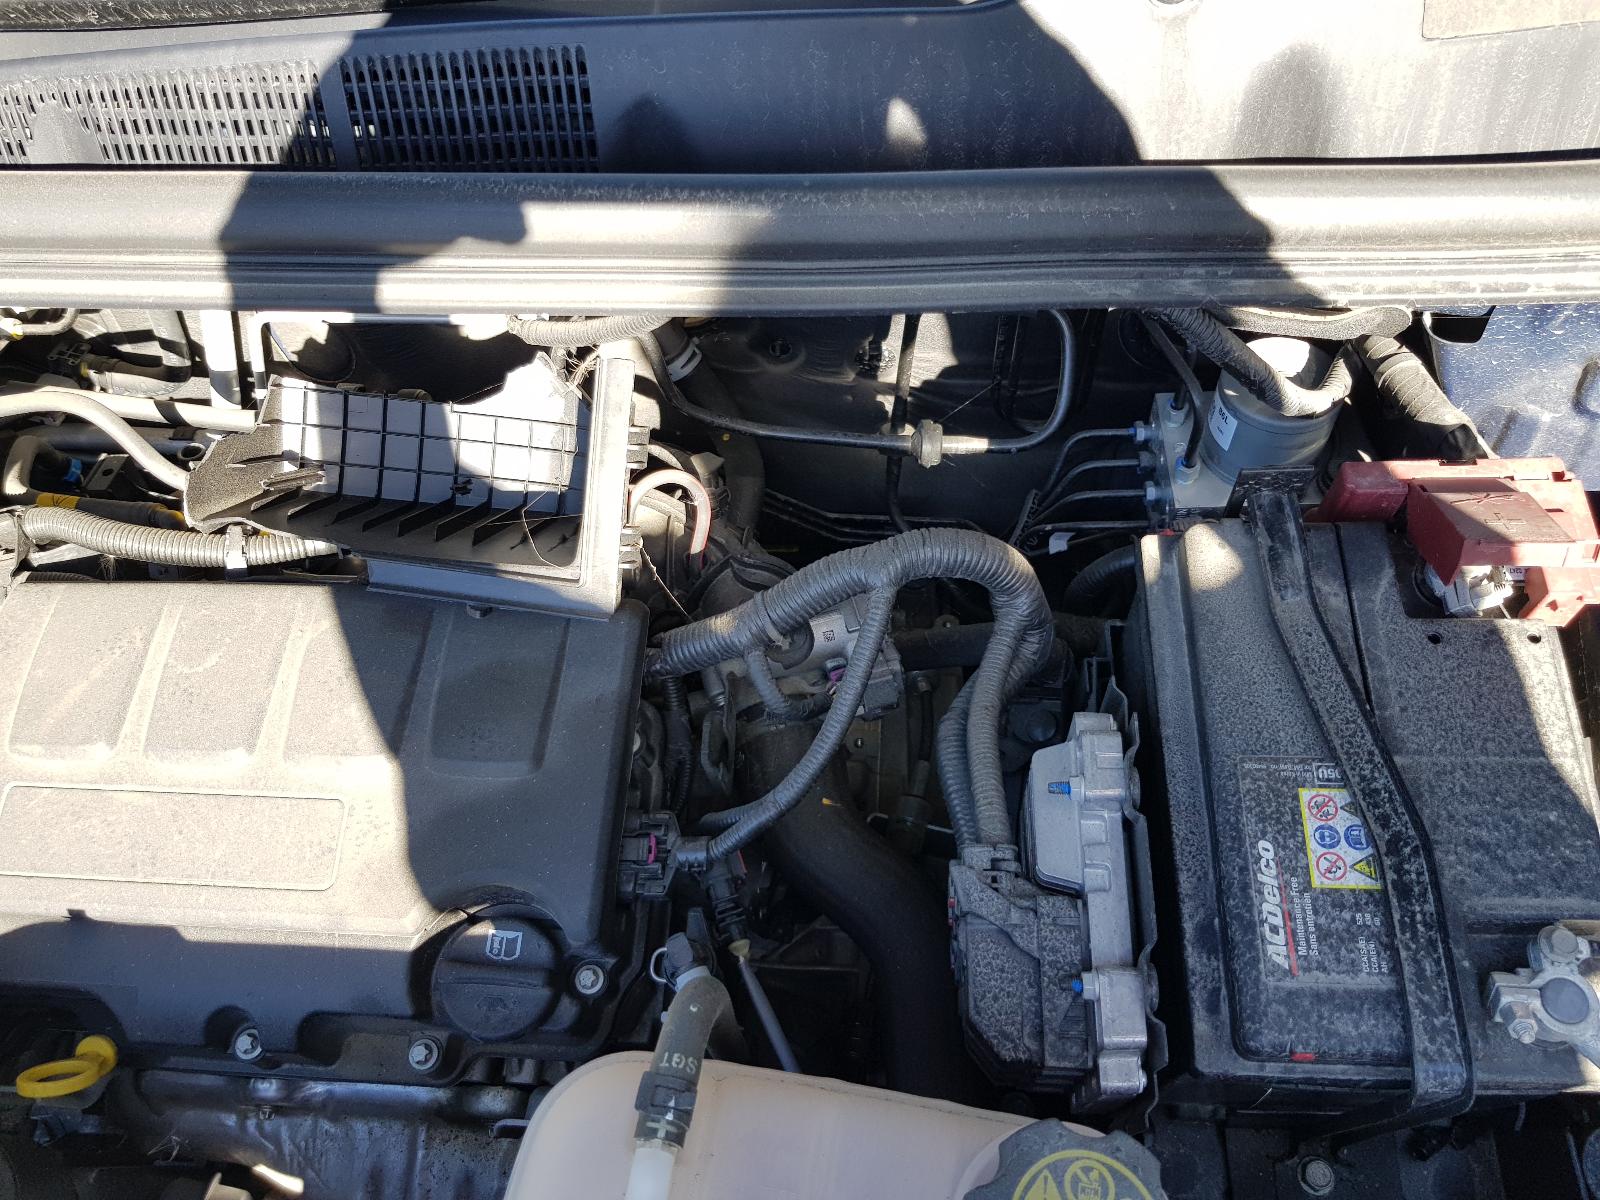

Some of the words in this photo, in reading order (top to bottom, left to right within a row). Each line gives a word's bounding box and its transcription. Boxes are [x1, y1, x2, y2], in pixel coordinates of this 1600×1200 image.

[1257, 839, 1290, 970] ACDelco
[1289, 876, 1300, 896] Free
[1293, 897, 1309, 956] Maintenance
[1302, 892, 1316, 931] entretien
[1308, 933, 1319, 956] Sans
